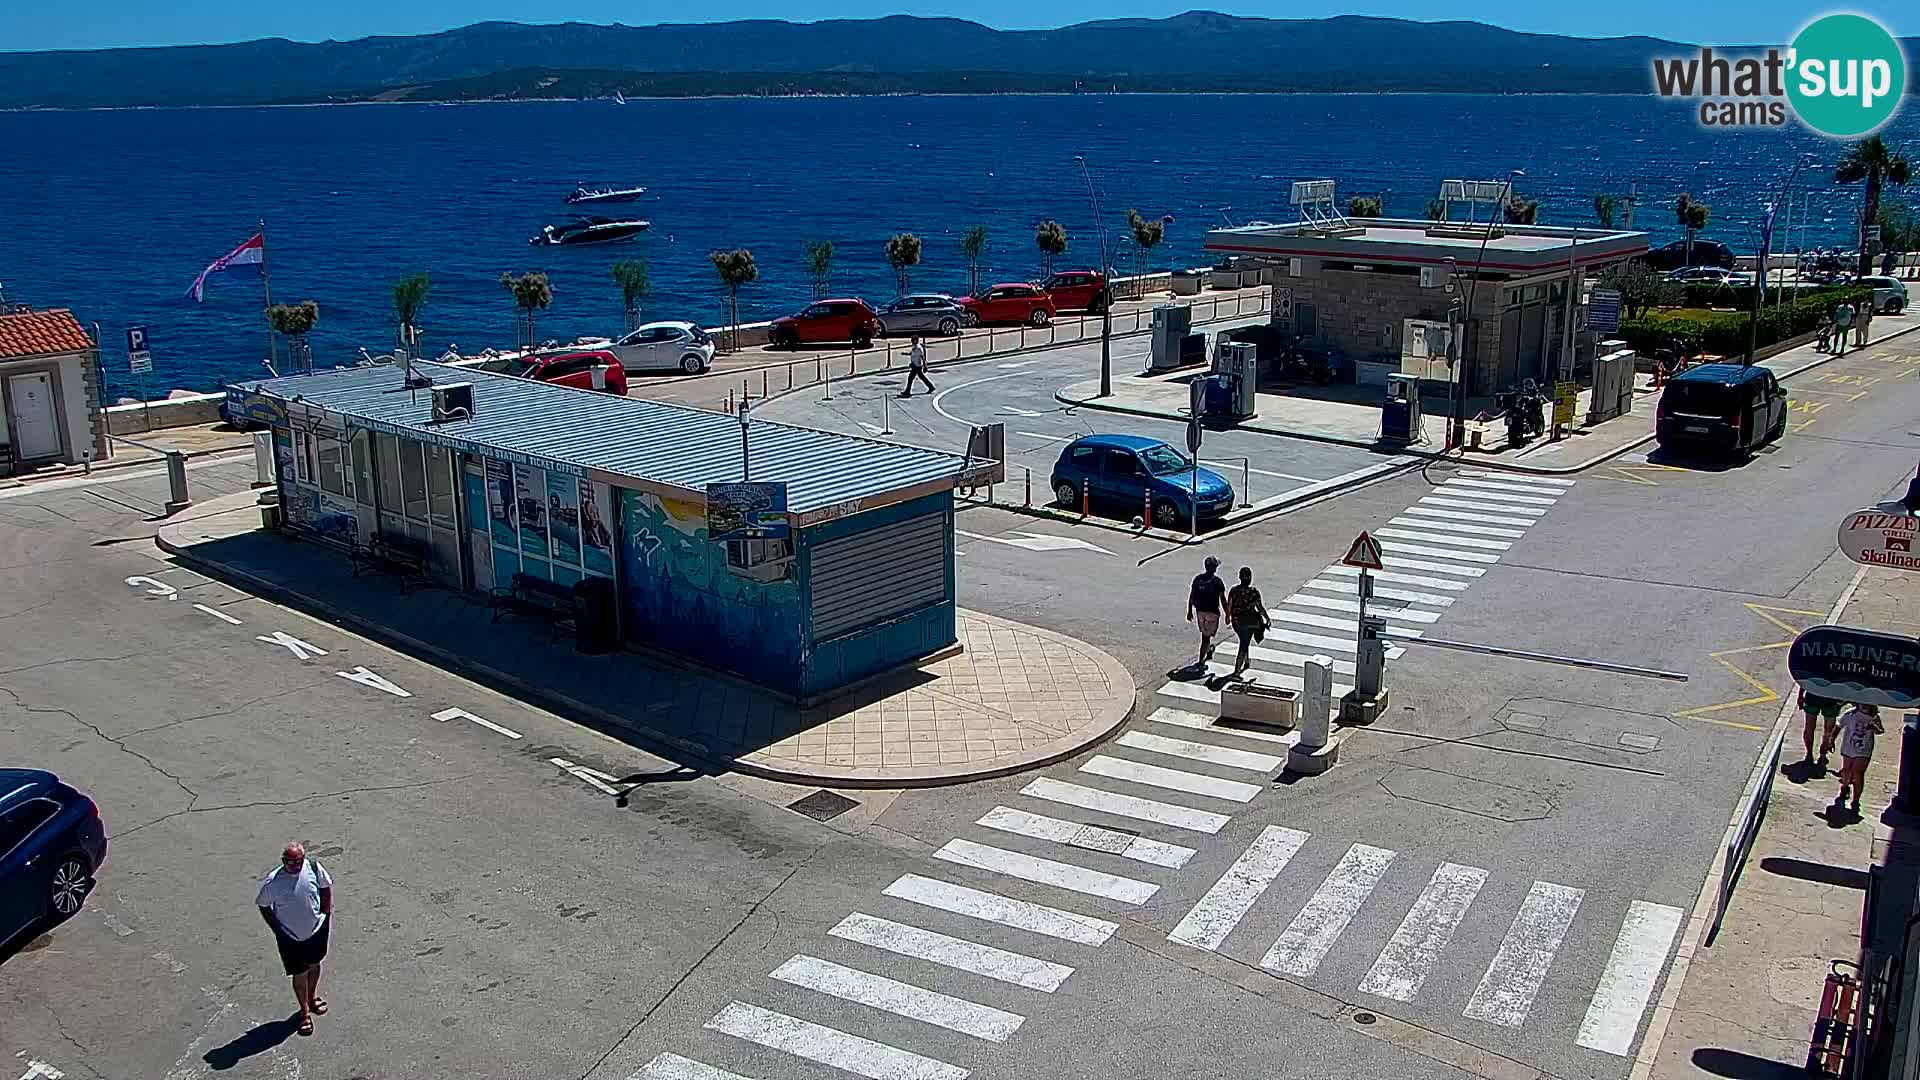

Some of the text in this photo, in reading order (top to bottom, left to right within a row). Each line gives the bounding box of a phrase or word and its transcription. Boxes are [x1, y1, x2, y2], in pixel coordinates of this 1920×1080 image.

[130, 330, 143, 348] P
[479, 445, 494, 457] BUS
[495, 449, 527, 464] STATION
[529, 456, 555, 470] TICKET
[557, 462, 583, 476] OFFICE
[1848, 514, 1920, 532] PIZZE
[1829, 661, 1897, 679] caffe bar
